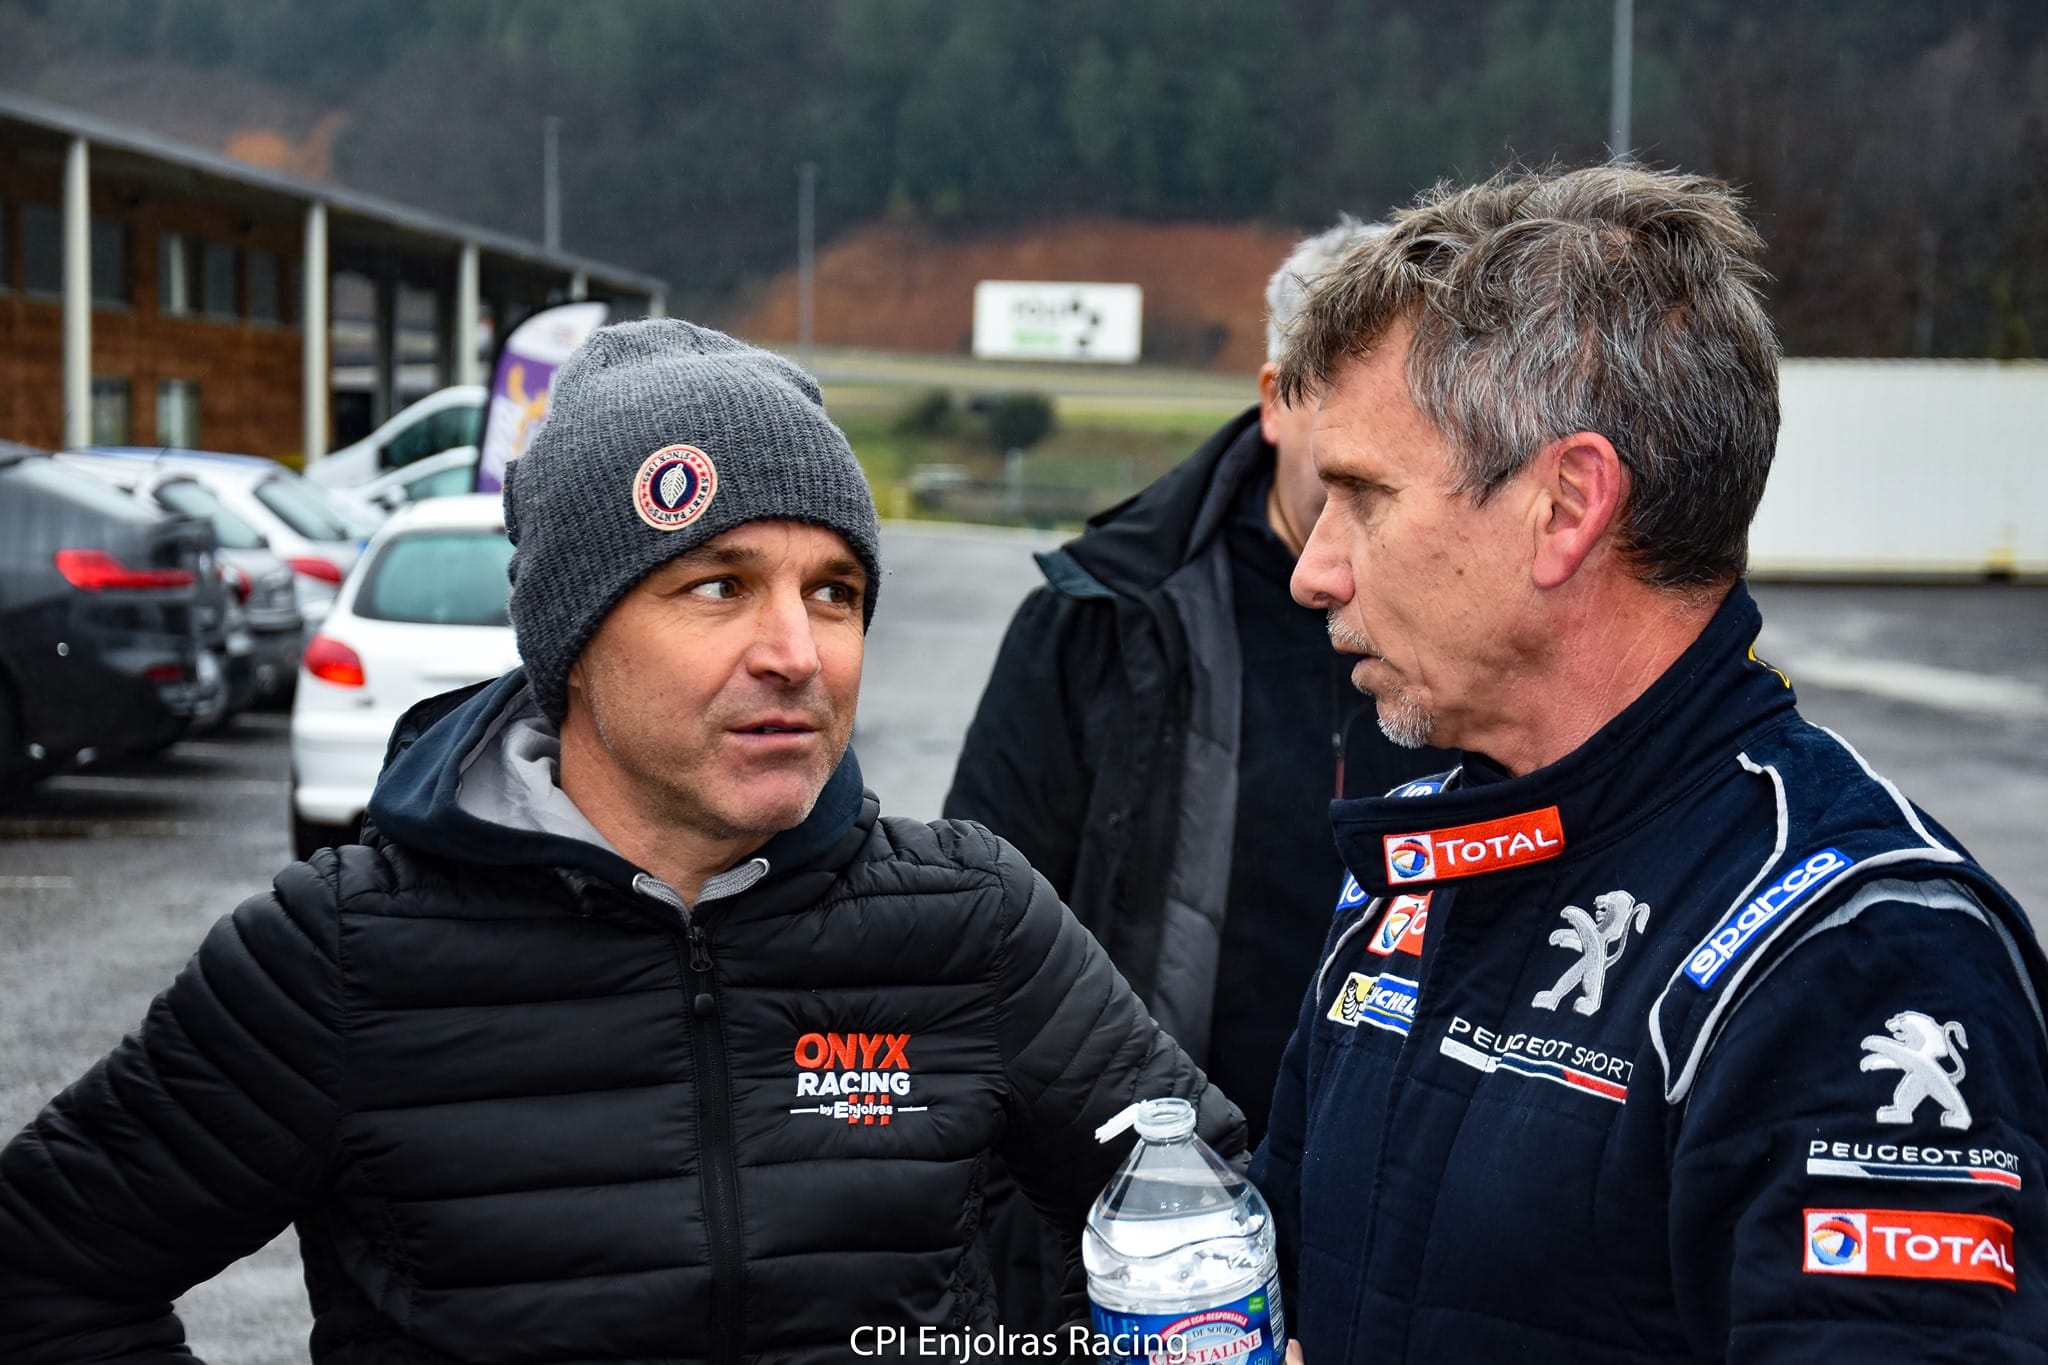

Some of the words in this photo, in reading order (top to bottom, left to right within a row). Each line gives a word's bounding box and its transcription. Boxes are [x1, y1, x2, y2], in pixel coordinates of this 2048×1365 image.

[688, 477, 709, 514] SWEET
[1435, 828, 1558, 865] TOTAL
[1690, 851, 1838, 976] sparco
[1367, 986, 1417, 1016] ICHEL
[794, 1032, 911, 1070] ONYX
[1448, 1016, 1574, 1060] PEUGEOT
[796, 1071, 911, 1097] RACING
[819, 1104, 833, 1116] by
[833, 1101, 893, 1119] Enjolras
[1809, 1140, 1963, 1164] PEUGEOT
[1968, 1148, 2021, 1171] SPORT
[1872, 1226, 2015, 1274] TOTAL
[1192, 1329, 1205, 1338] DE
[1207, 1325, 1241, 1336] SOURCE
